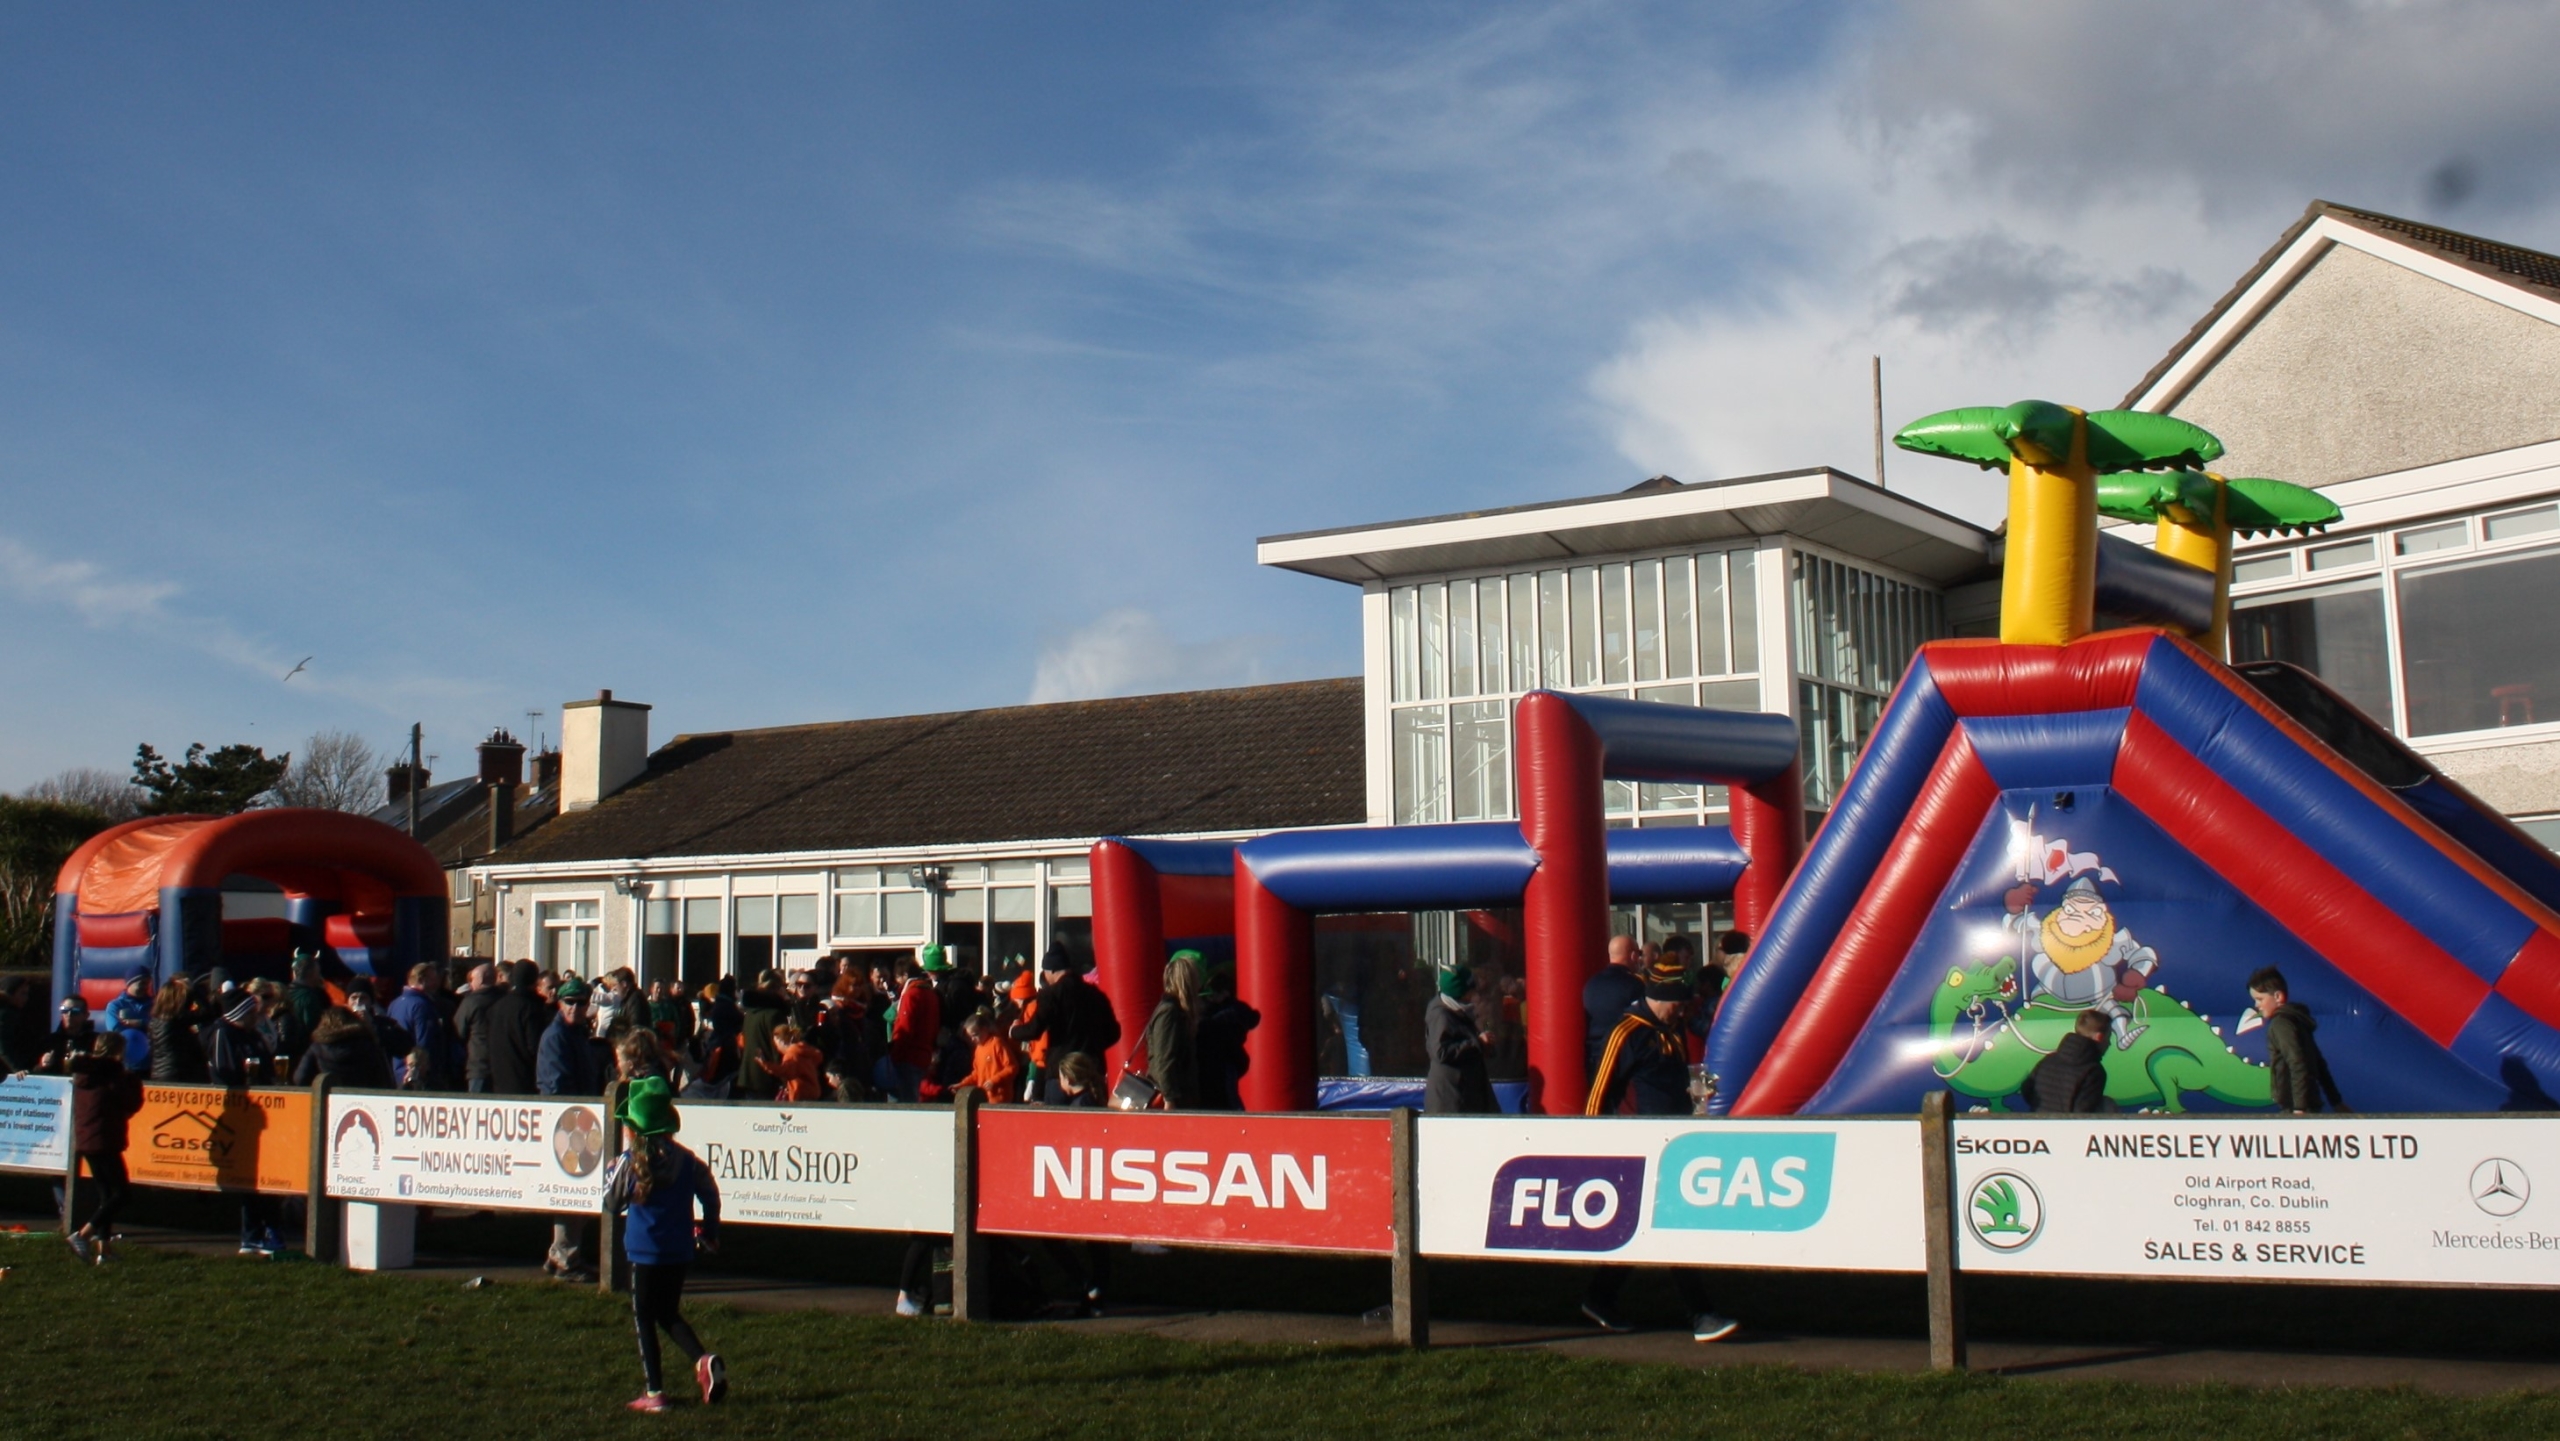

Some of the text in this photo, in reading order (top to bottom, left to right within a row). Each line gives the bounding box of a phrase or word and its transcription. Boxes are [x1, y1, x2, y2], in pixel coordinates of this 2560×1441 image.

[38, 1097, 62, 1106] printers
[23, 1109, 55, 1120] stationery
[13, 1121, 34, 1130] lowest
[394, 1105, 471, 1140] BOMBAY
[476, 1107, 542, 1142] HOUSE
[753, 1122, 808, 1135] Country Crest
[152, 1133, 235, 1156] Casey
[1956, 1135, 2051, 1155] ŠKODA
[2085, 1134, 2419, 1160] ANNESLEY WILLIAMS LTD
[420, 1150, 512, 1176] INDIAN CUISINE
[706, 1143, 859, 1184] FARM SHOP
[336, 1174, 366, 1184] PHONE
[1032, 1145, 1328, 1211] NISSAN
[1679, 1156, 1807, 1209] GAS
[2185, 1176, 2315, 1191] Old Airport Road,
[341, 1186, 357, 1195] 849
[358, 1187, 380, 1197] 4207
[415, 1182, 523, 1199] /bombayhouseskerries
[538, 1183, 550, 1193] 24
[552, 1184, 589, 1195] STRAND
[549, 1197, 593, 1208] SKERRIES
[1510, 1178, 1620, 1229] FLO
[2173, 1195, 2329, 1210] Cloghran, Co. Dublin
[738, 1208, 823, 1221] www.countrycrest.ie
[2193, 1219, 2311, 1234] Tel. 01 842 8855
[2144, 1241, 2366, 1265] SALES & SERVICE
